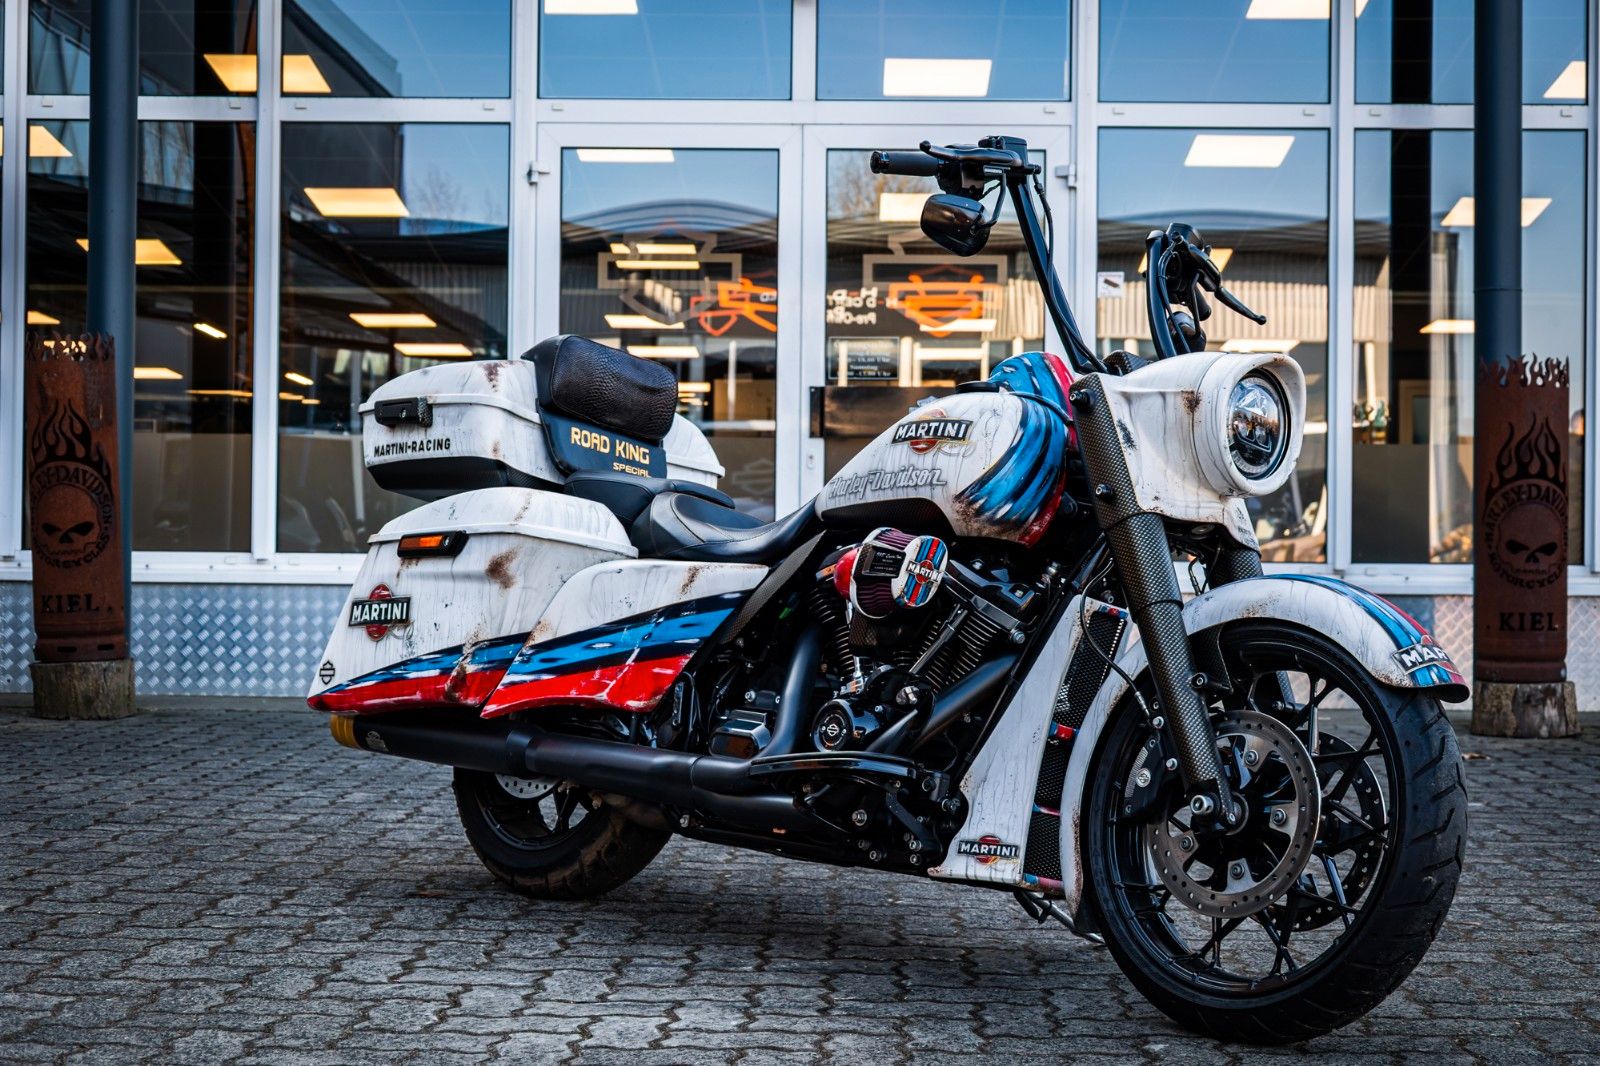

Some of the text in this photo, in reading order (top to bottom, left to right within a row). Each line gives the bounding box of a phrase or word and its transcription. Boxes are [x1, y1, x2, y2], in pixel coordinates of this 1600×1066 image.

[895, 422, 967, 440] MARTINI
[570, 426, 650, 465] ROAD KING
[612, 461, 652, 478] SPECIAL
[829, 464, 948, 500] Harley-Davidson
[41, 592, 99, 614] KIEL
[351, 602, 408, 623] MARTINI
[1499, 612, 1558, 632] KIEL
[960, 841, 1017, 857] MARTINI
